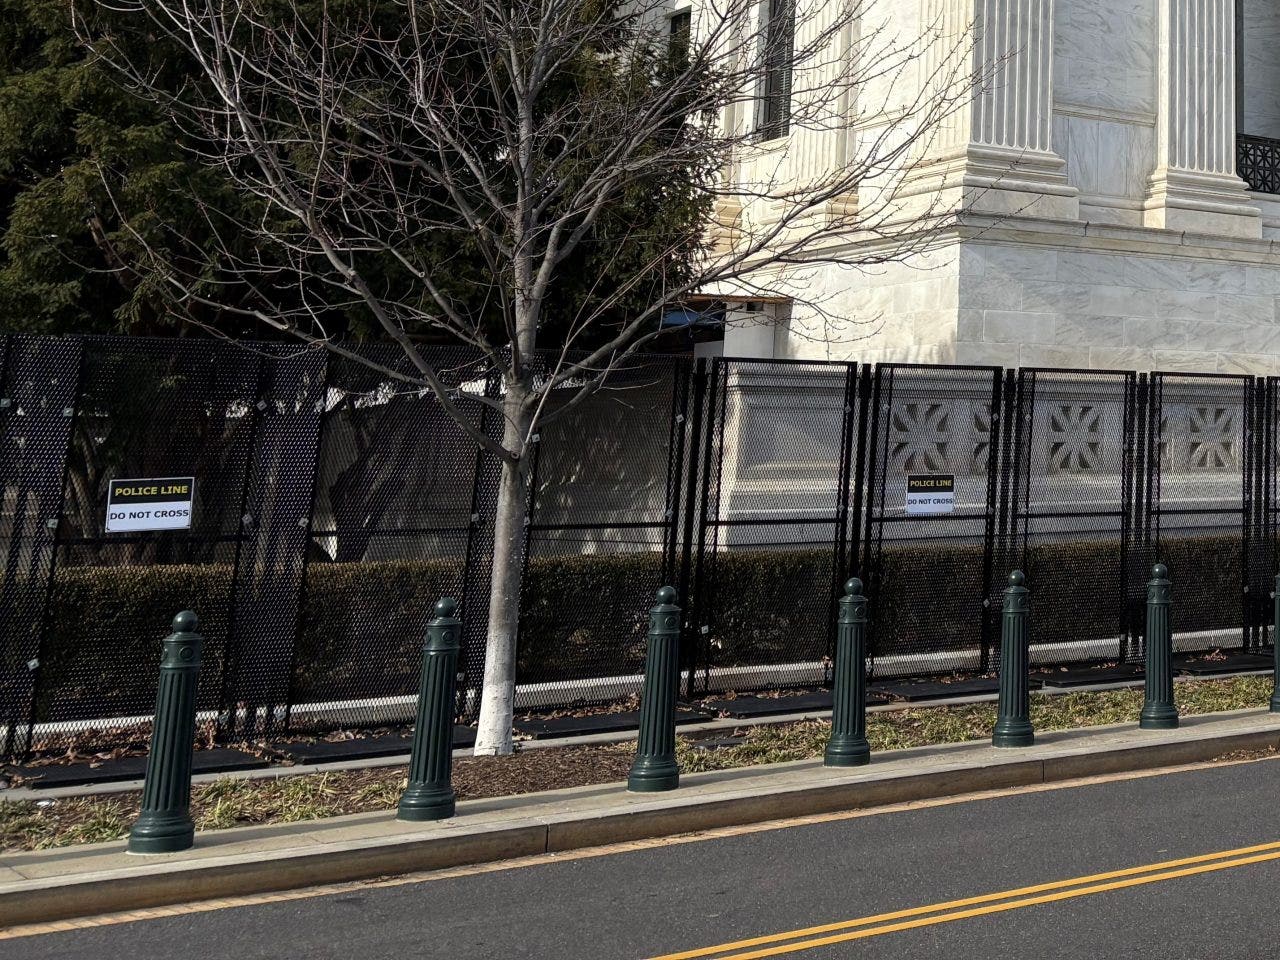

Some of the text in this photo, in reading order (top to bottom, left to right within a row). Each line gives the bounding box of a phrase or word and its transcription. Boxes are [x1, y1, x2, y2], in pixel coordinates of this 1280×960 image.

[115, 485, 189, 496] POLICE LINE
[110, 509, 189, 520] DO NOT CROSS
